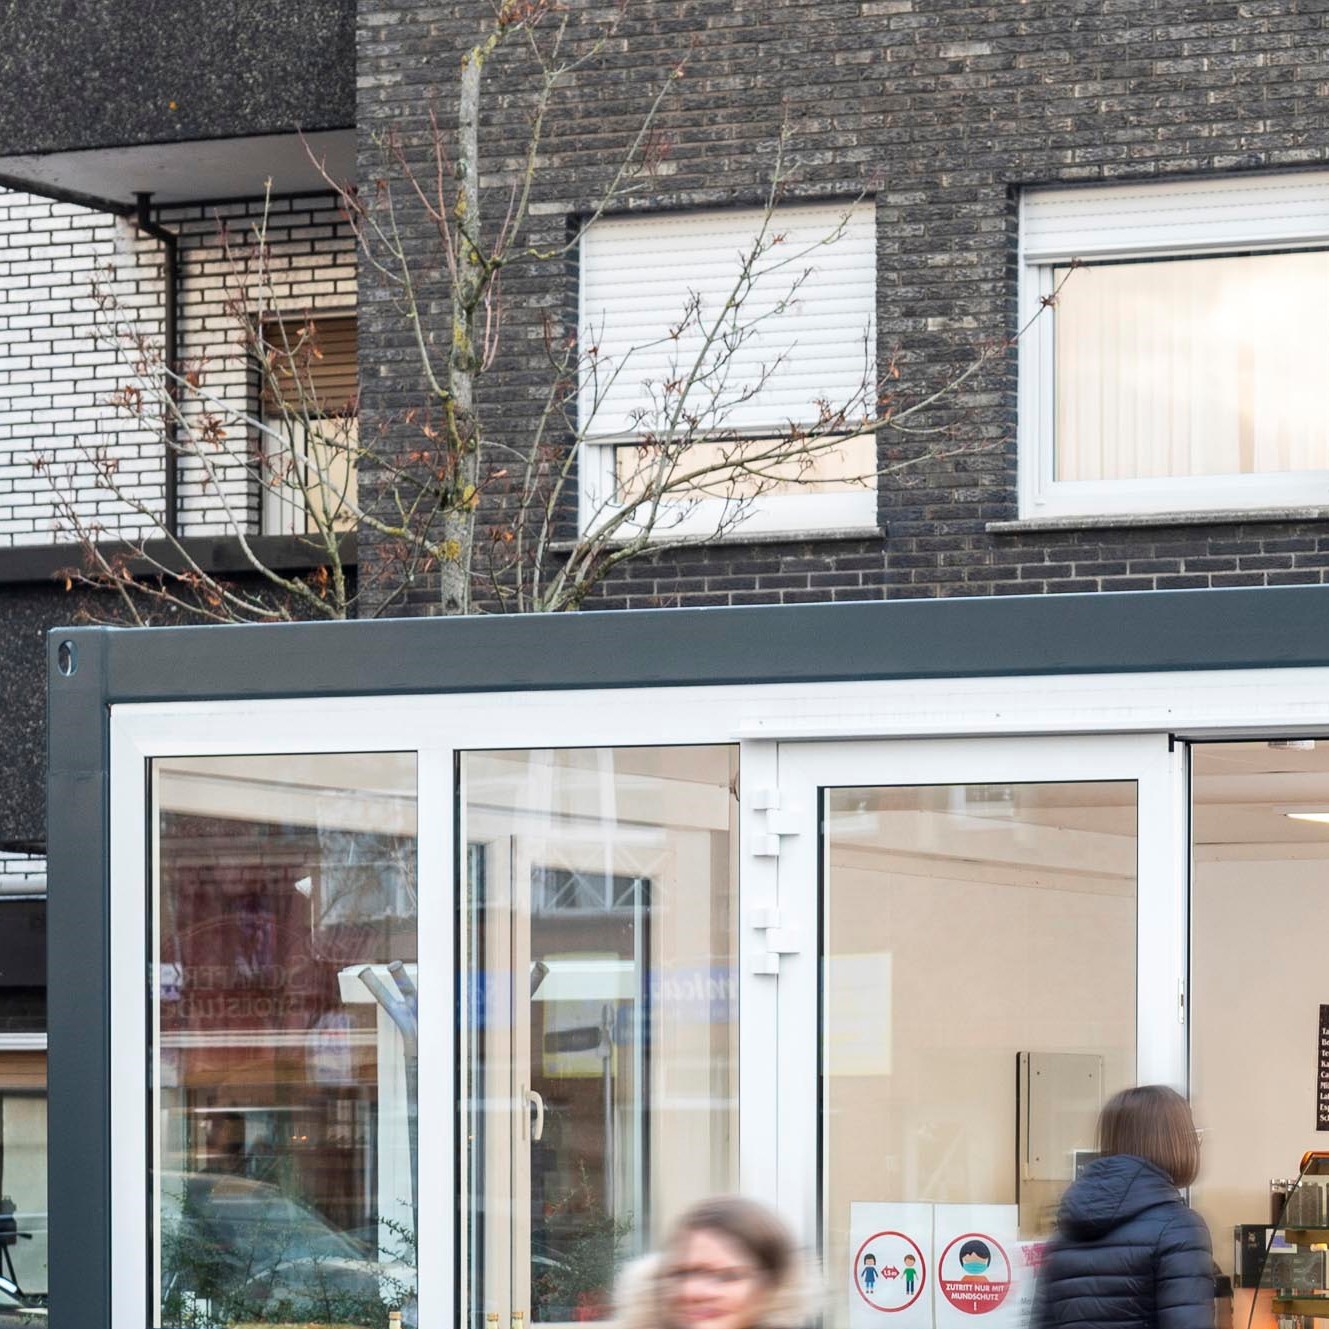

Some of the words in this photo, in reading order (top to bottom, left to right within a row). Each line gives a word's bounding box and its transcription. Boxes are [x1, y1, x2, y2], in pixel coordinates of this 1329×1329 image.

[945, 1283, 973, 1291] ZUTRITT
[991, 1284, 1005, 1292] MIT
[951, 1293, 999, 1301] MUNDSCHUTZ
